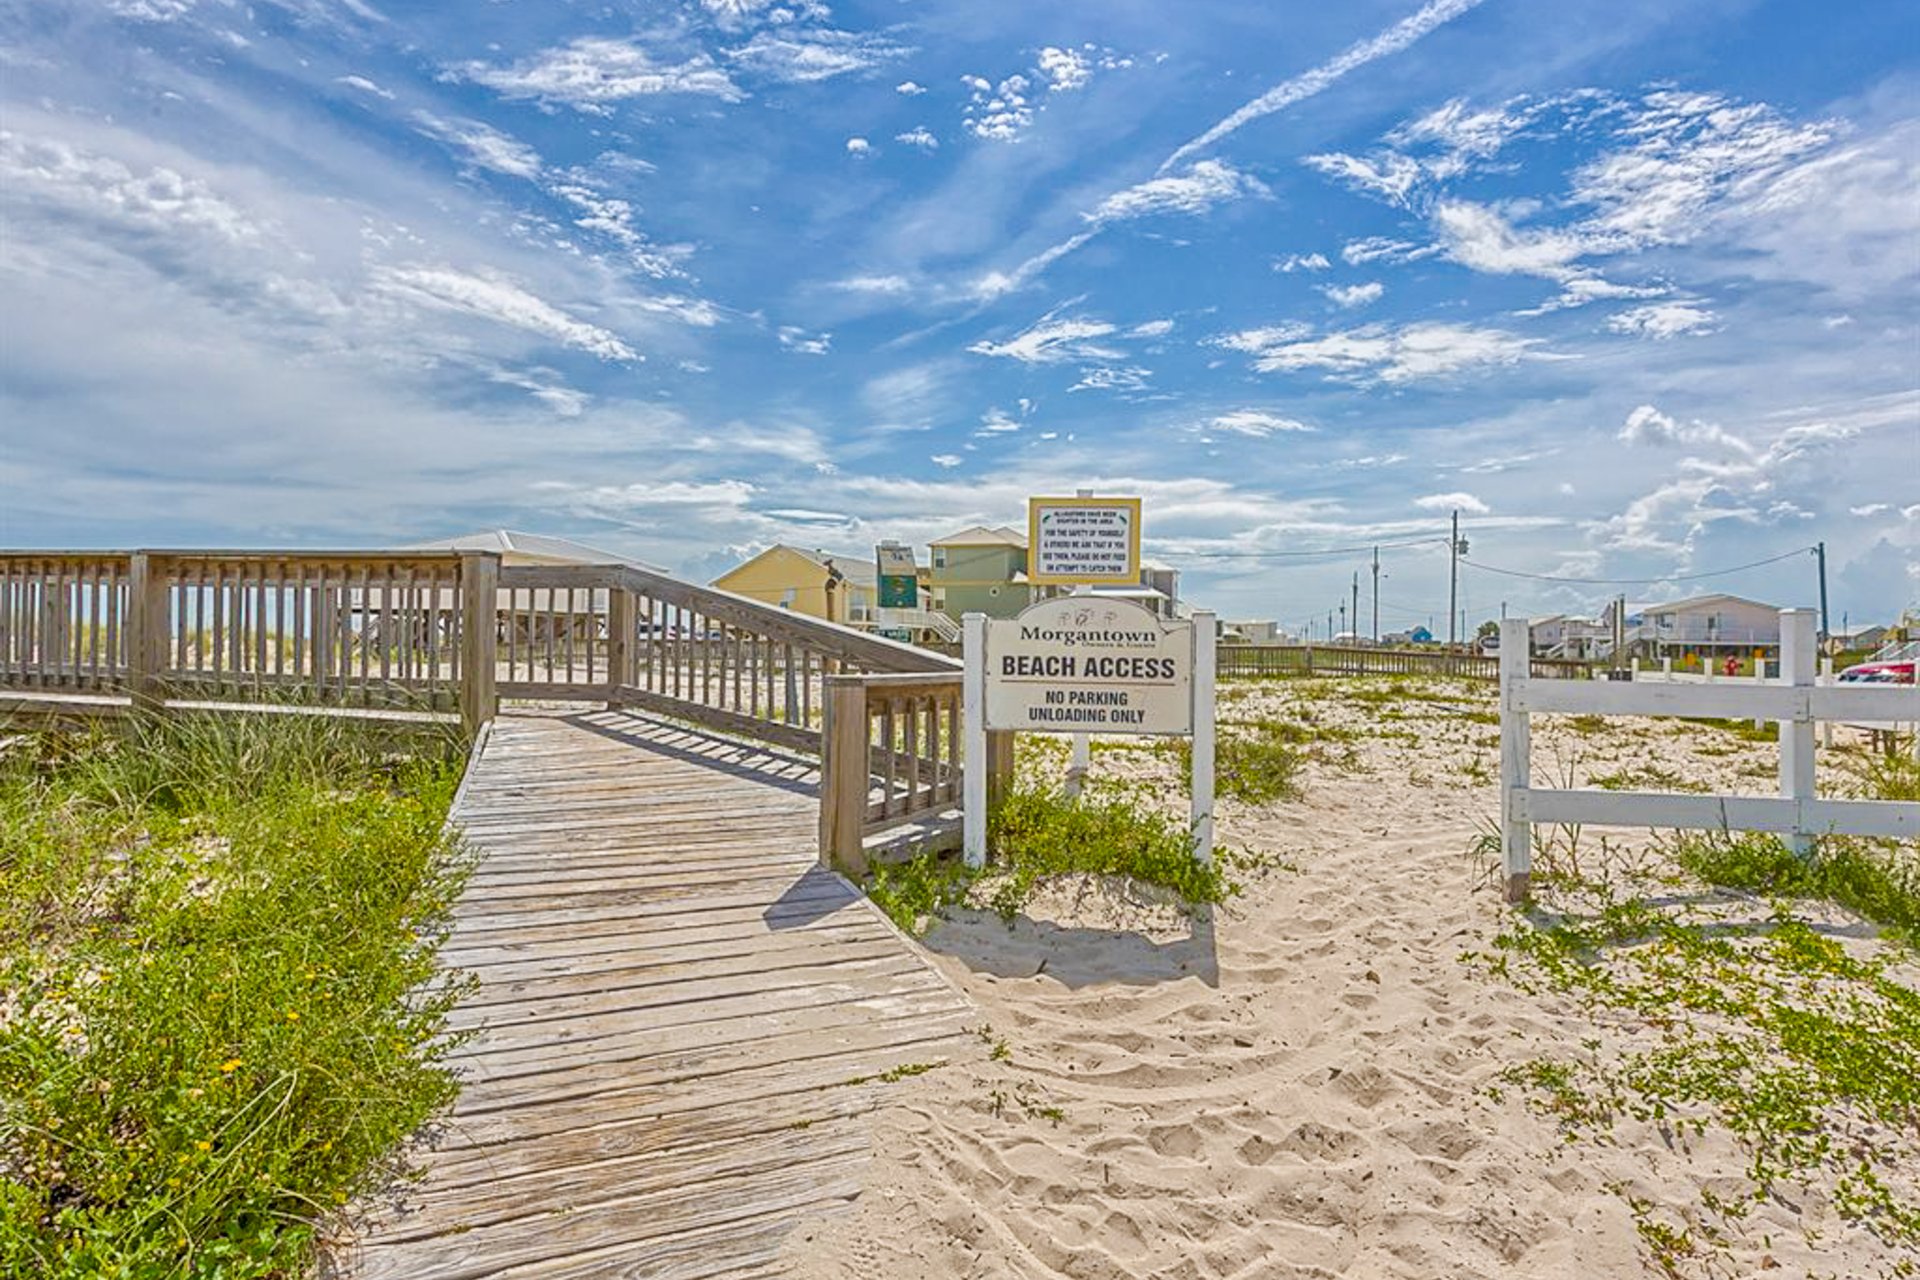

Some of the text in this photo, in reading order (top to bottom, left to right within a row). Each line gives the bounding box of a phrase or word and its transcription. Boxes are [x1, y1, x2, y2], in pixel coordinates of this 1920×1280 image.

[1045, 529, 1056, 537] FOR
[1057, 529, 1067, 537] THE
[1068, 529, 1088, 537] SAFETY
[1020, 626, 1156, 646] Morgantown
[1002, 655, 1176, 679] BEACH ACCESS
[1045, 690, 1128, 706] NO PARKING
[1029, 707, 1145, 724] UNLOADING ONLY
